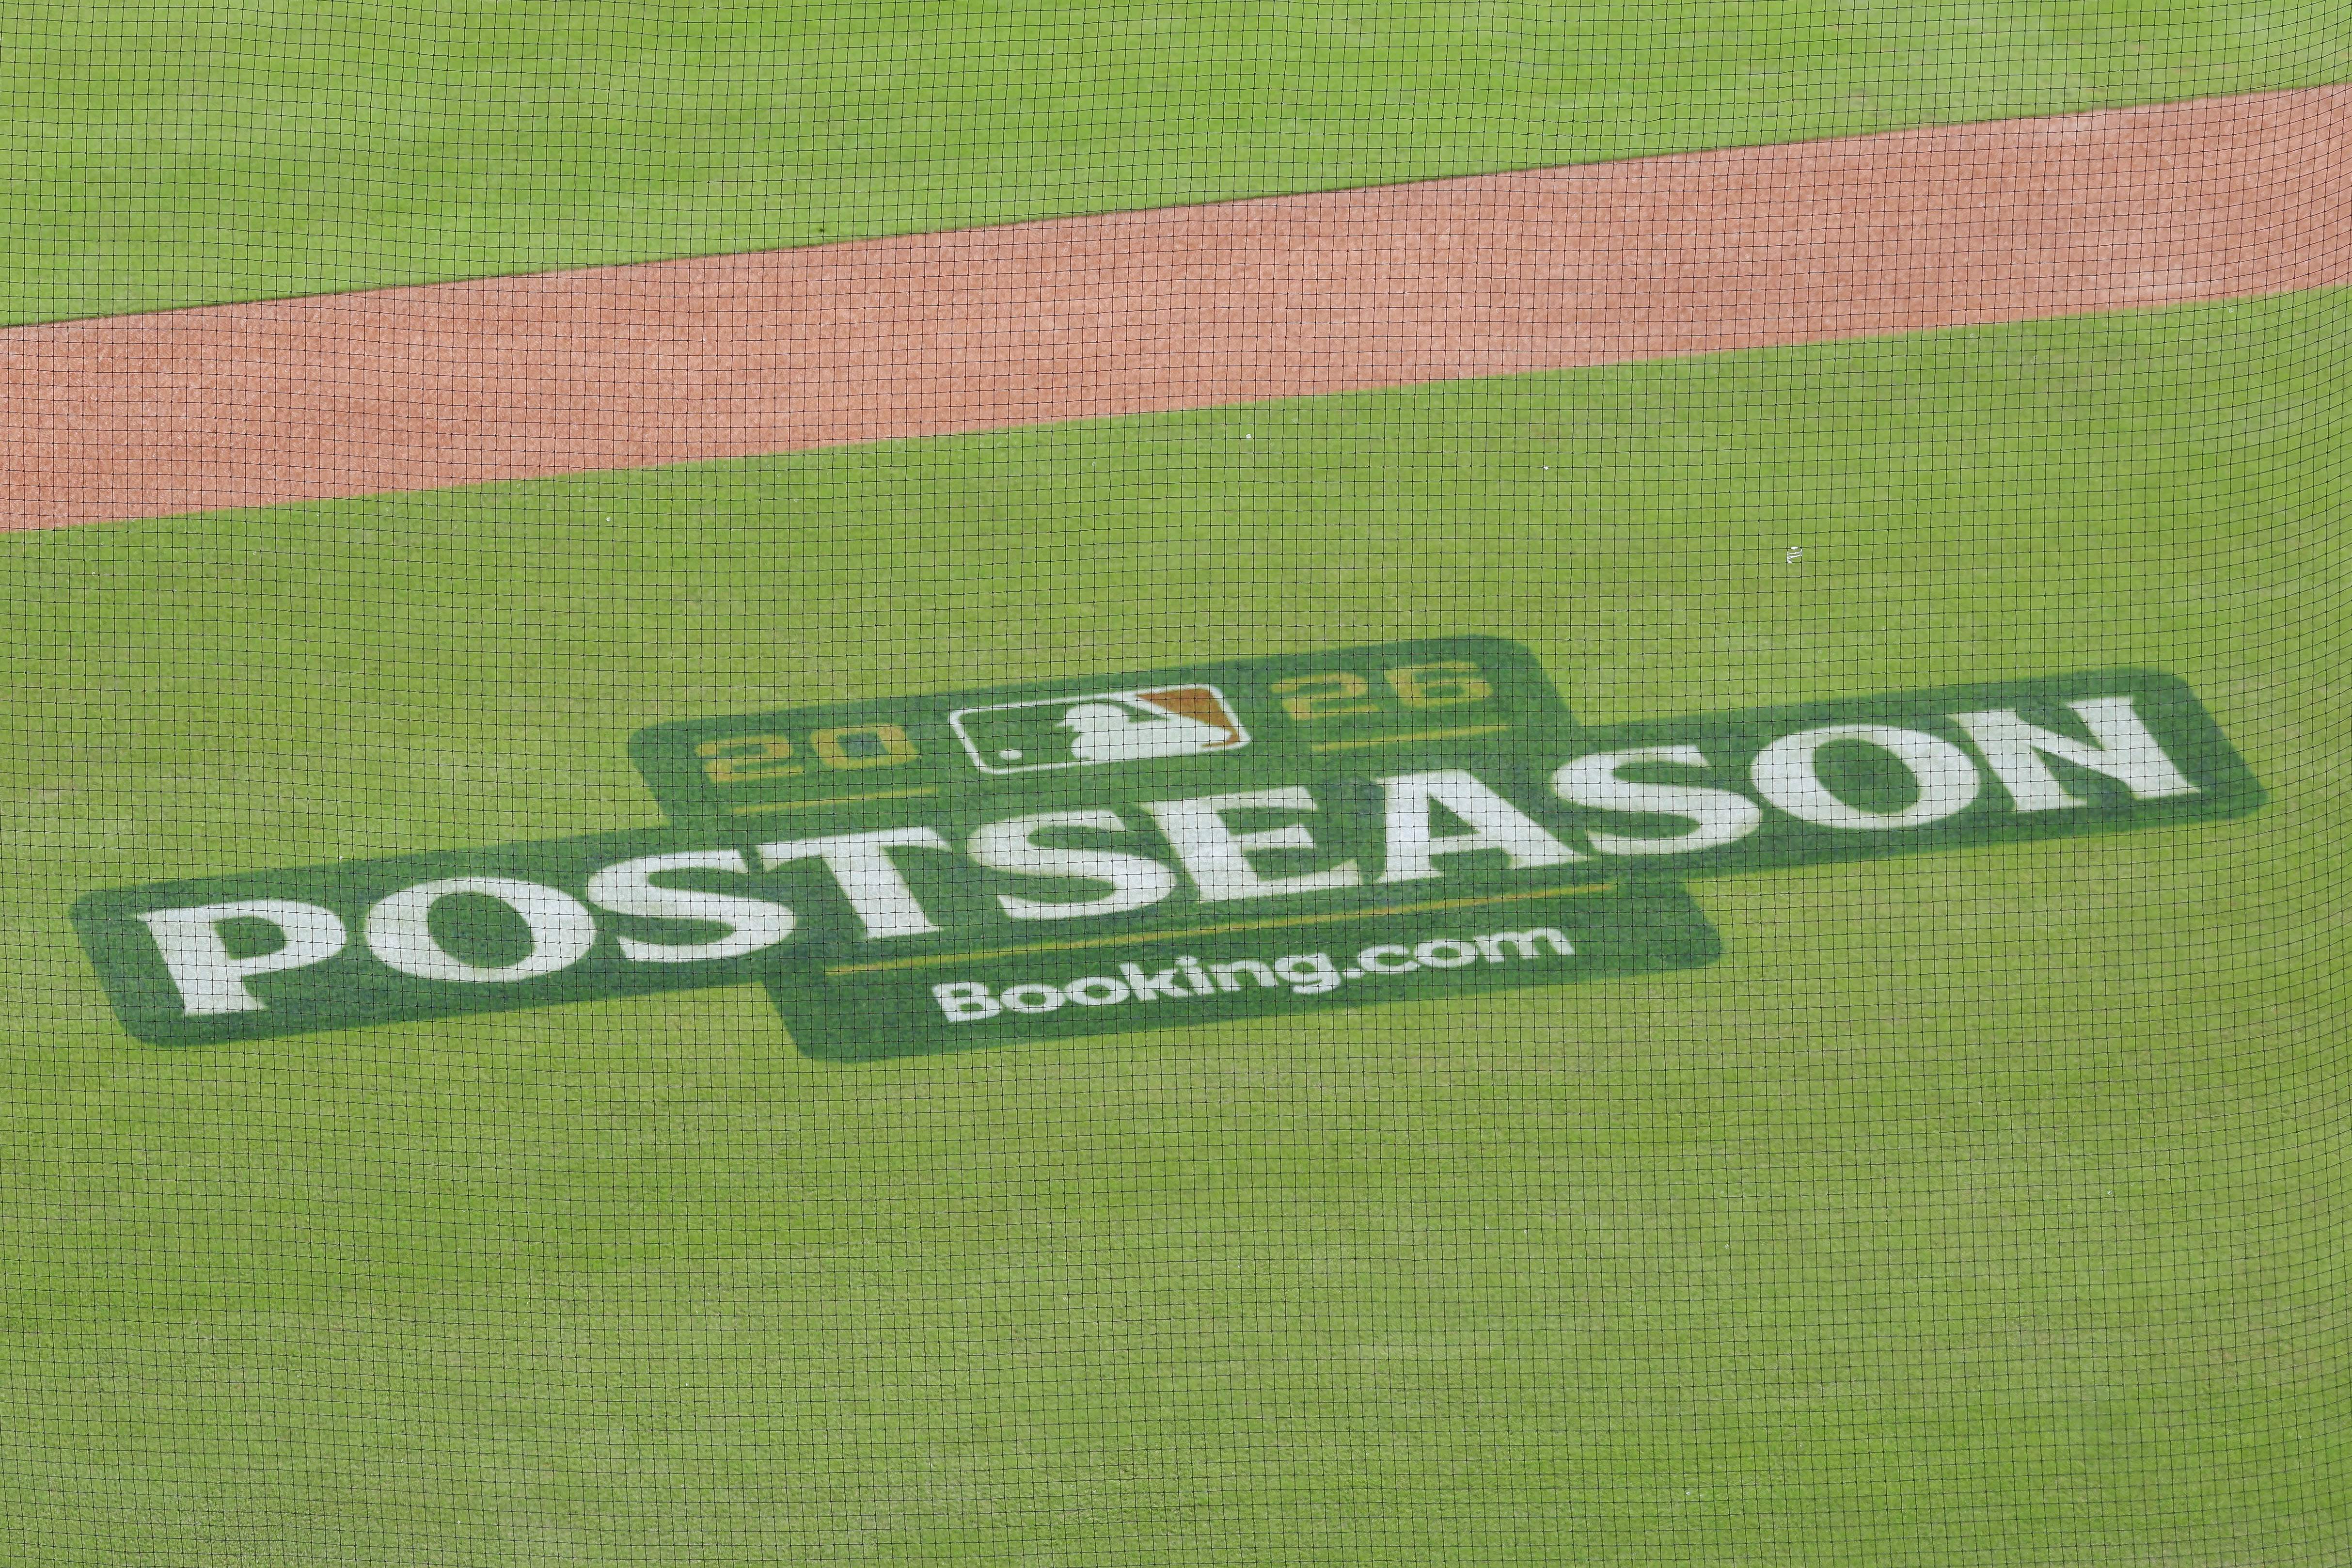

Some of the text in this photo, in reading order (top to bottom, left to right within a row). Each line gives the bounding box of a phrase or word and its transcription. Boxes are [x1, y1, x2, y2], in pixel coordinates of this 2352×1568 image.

[696, 661, 1493, 783] 20 26
[137, 695, 2198, 1017] POSTSEASON
[931, 926, 1573, 1022] Booking.com
